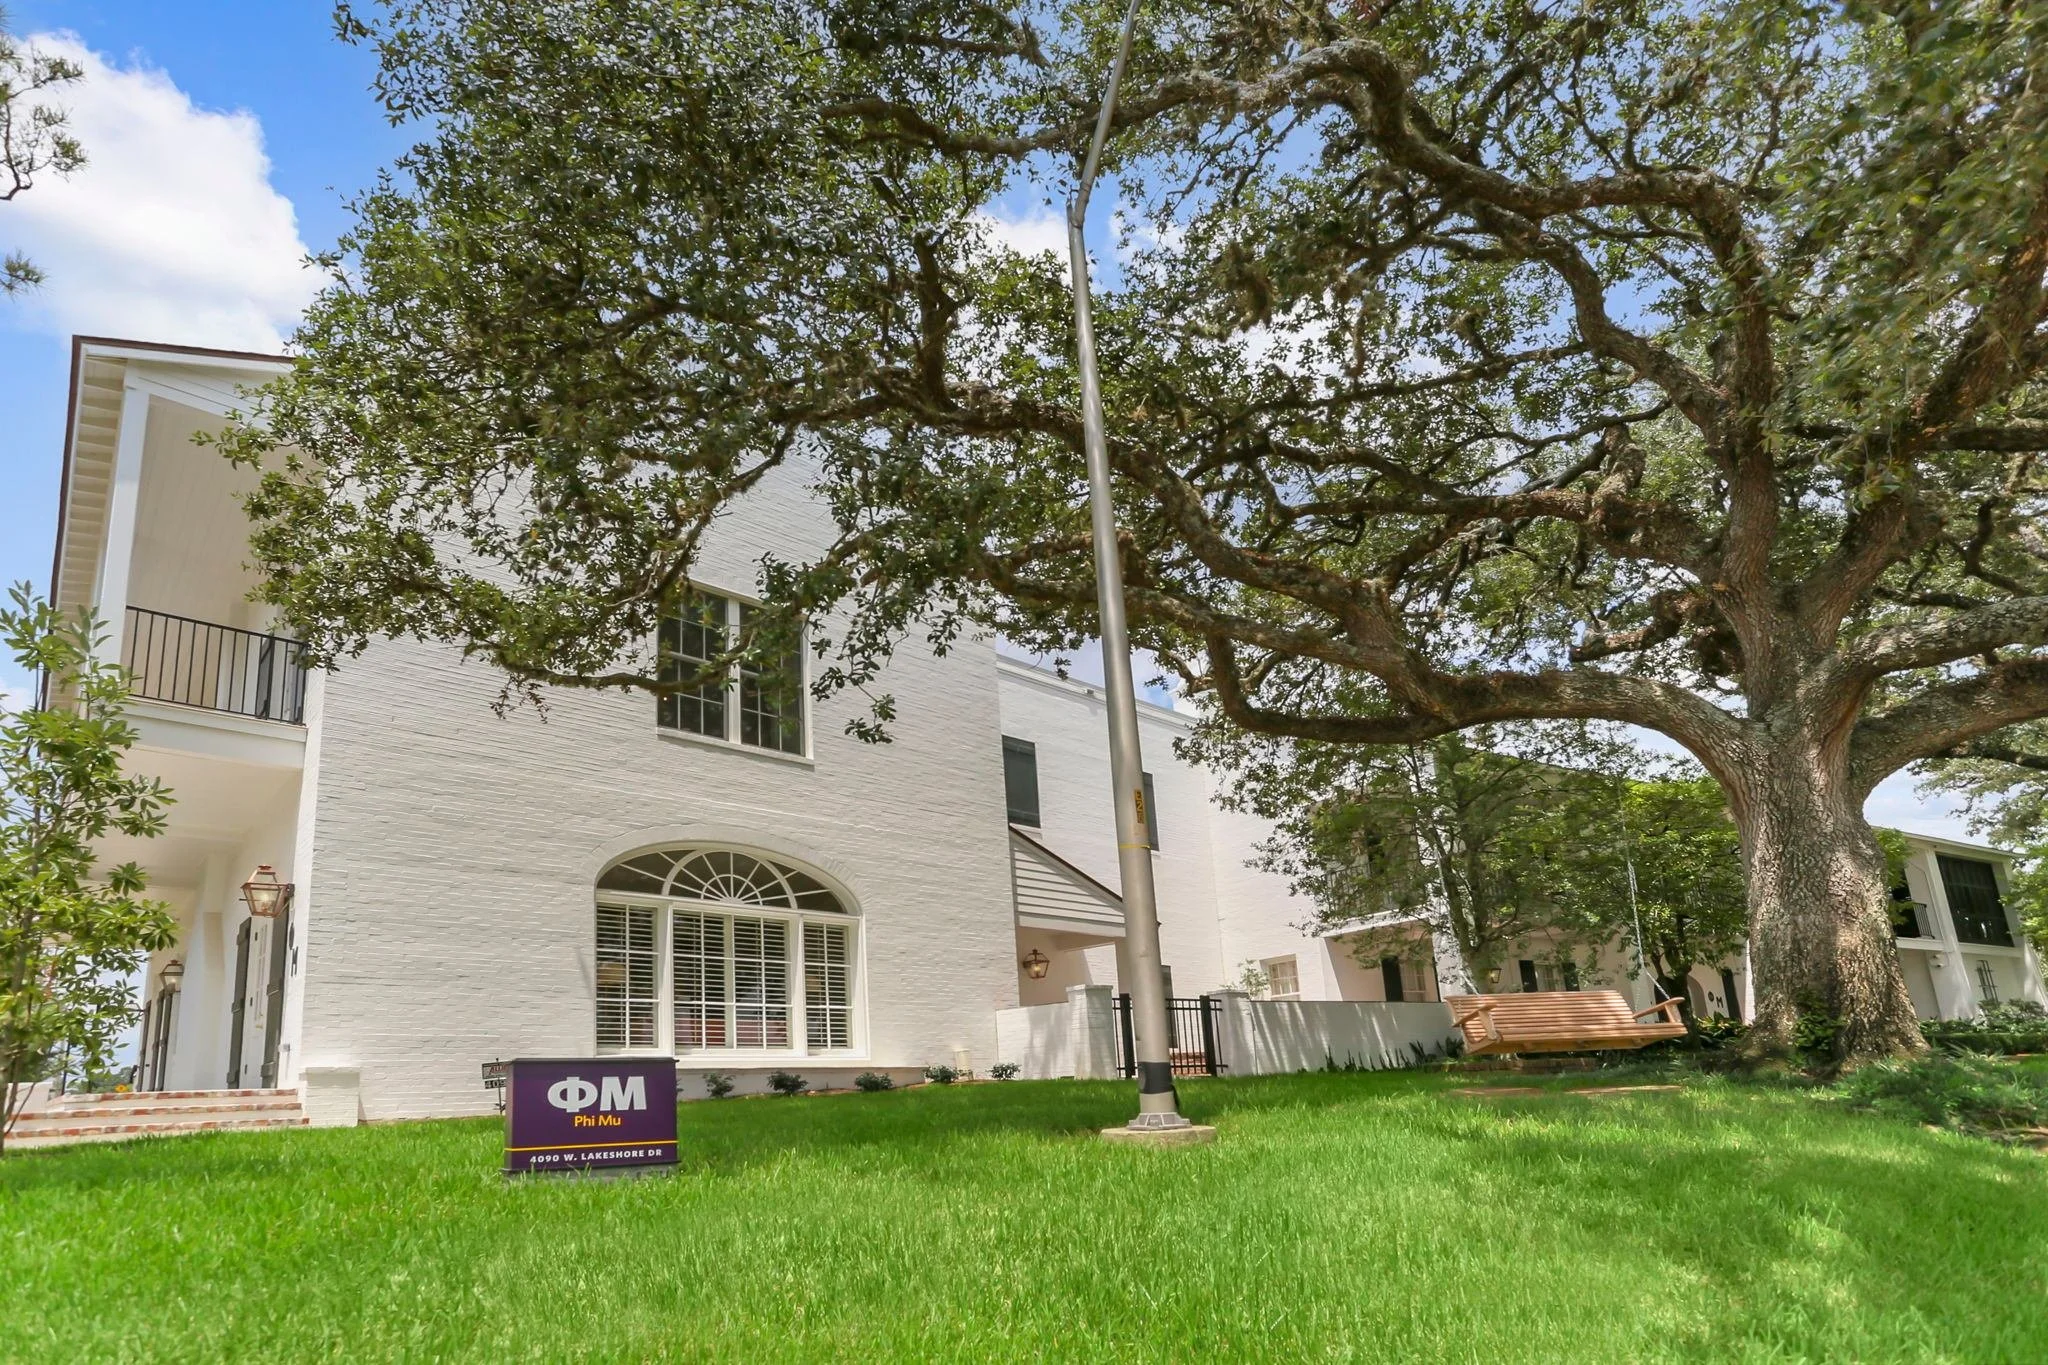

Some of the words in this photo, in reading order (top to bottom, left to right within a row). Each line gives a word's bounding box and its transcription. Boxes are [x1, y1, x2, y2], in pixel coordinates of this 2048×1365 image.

[574, 1115, 595, 1127] Phi
[599, 1114, 621, 1127] Mu
[530, 1154, 560, 1163] 4090
[563, 1153, 577, 1162] W.
[581, 1149, 645, 1161] LAKESHORE
[648, 1149, 662, 1157] DR
